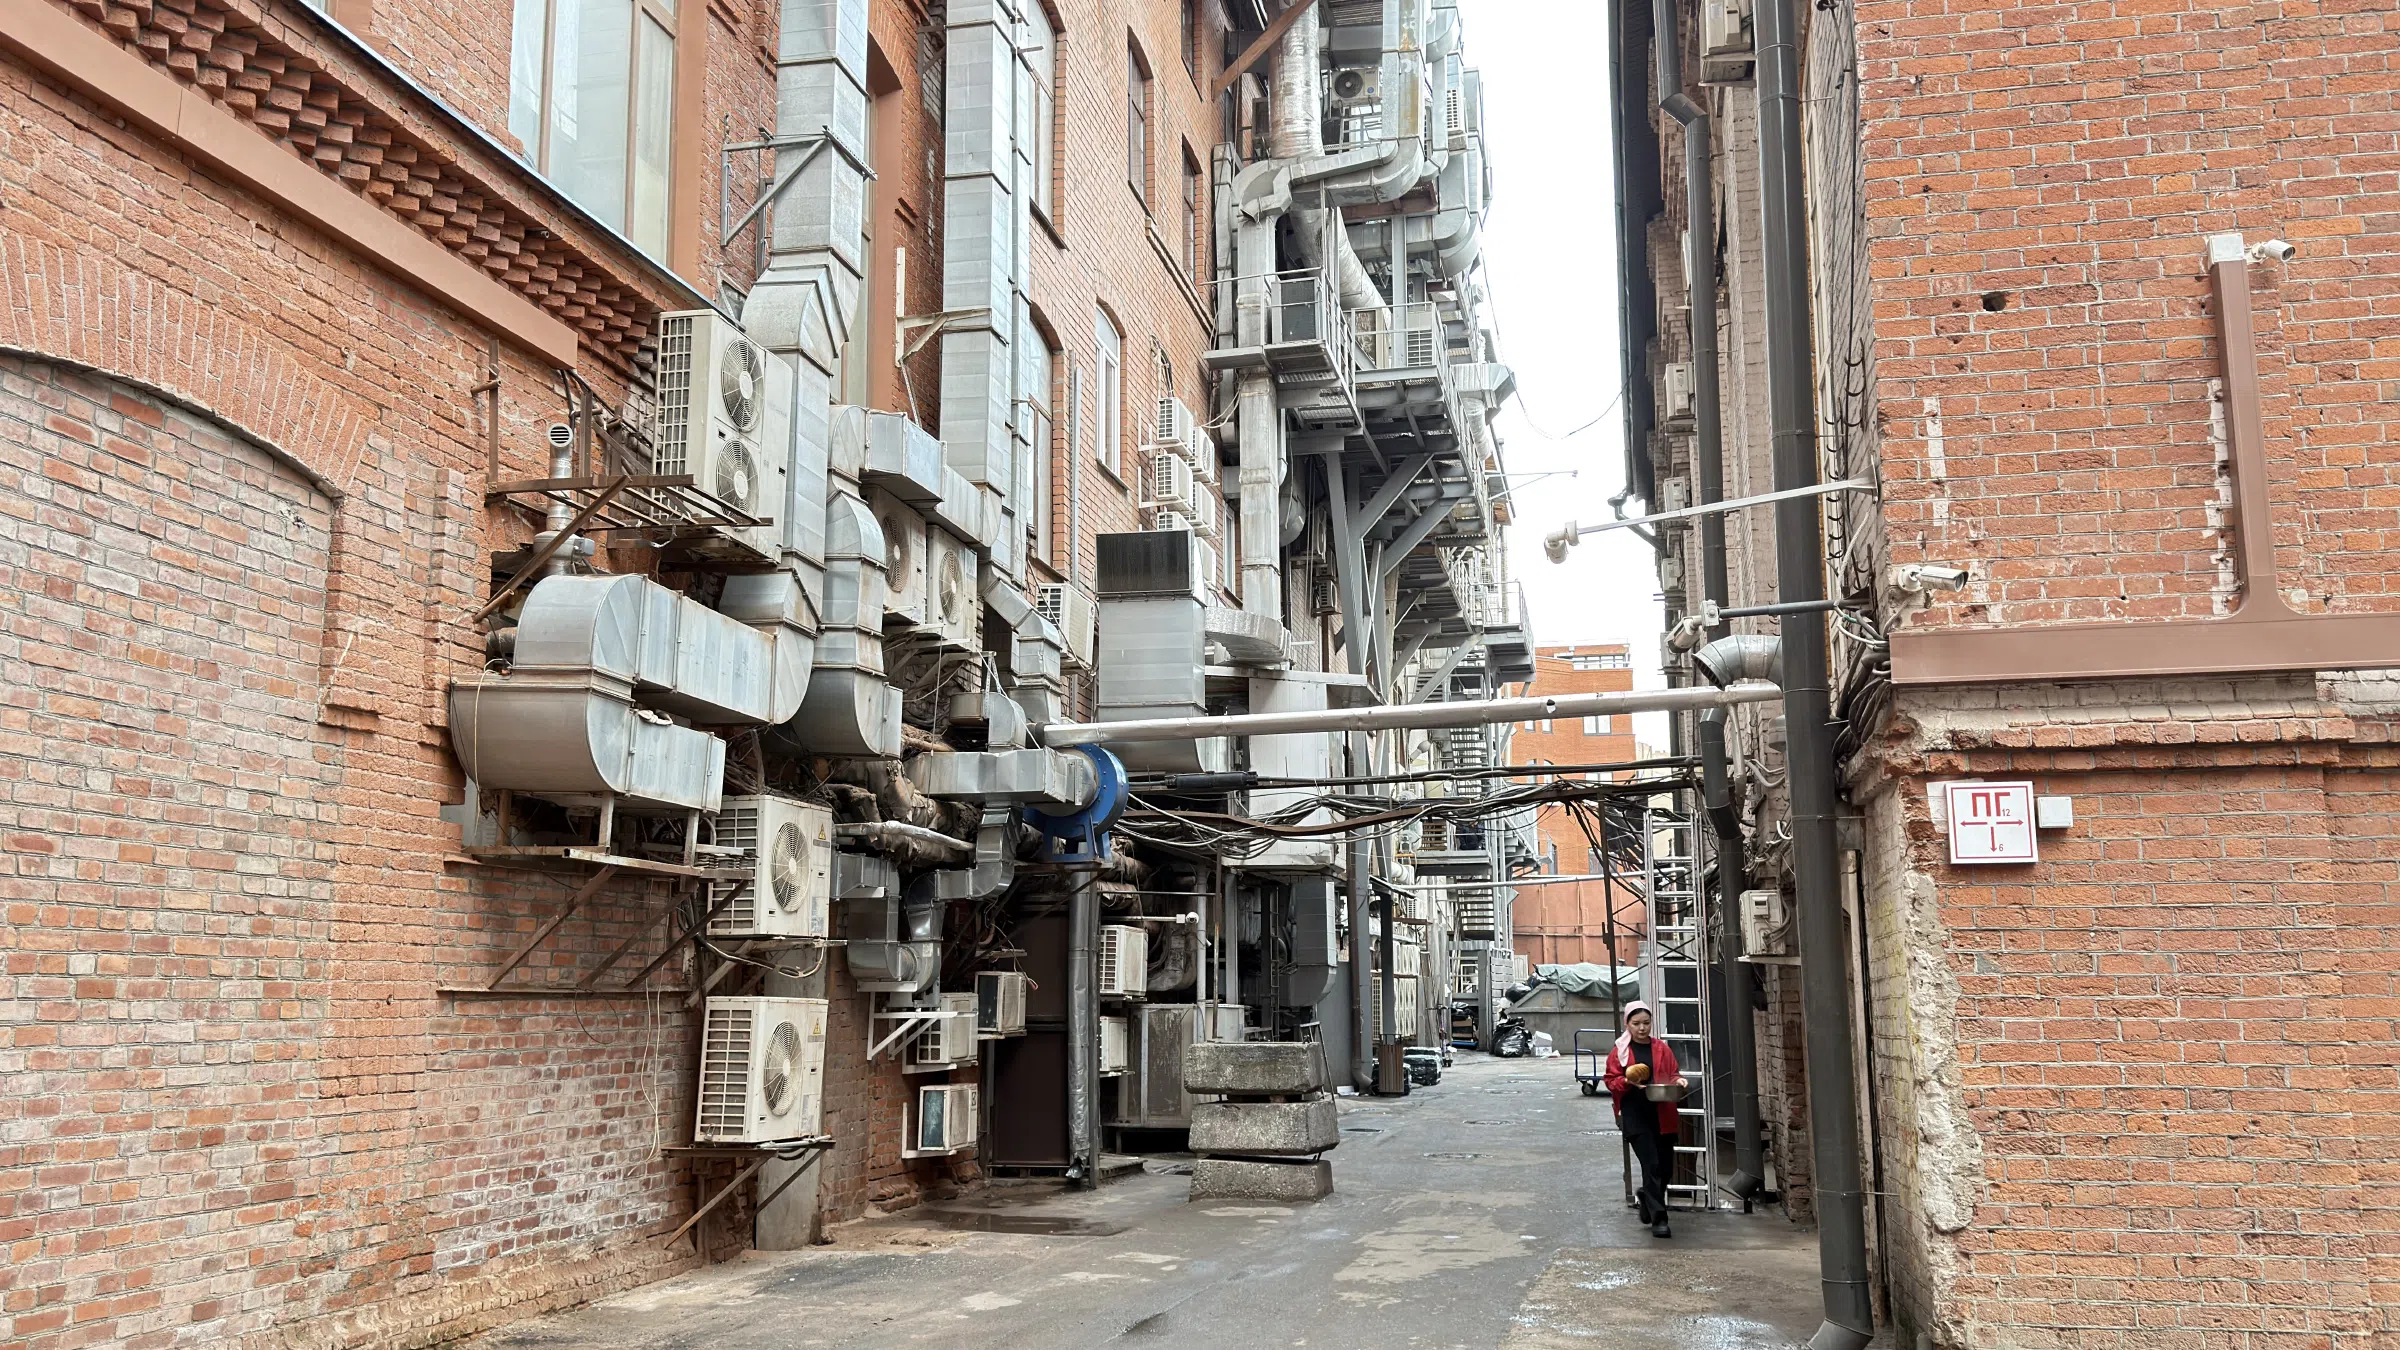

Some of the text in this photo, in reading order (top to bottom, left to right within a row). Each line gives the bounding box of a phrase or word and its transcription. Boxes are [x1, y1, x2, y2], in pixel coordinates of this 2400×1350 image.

[1972, 792, 2010, 817] ПГ
[2002, 808, 2011, 817] 12
[1998, 843, 2004, 852] 6
